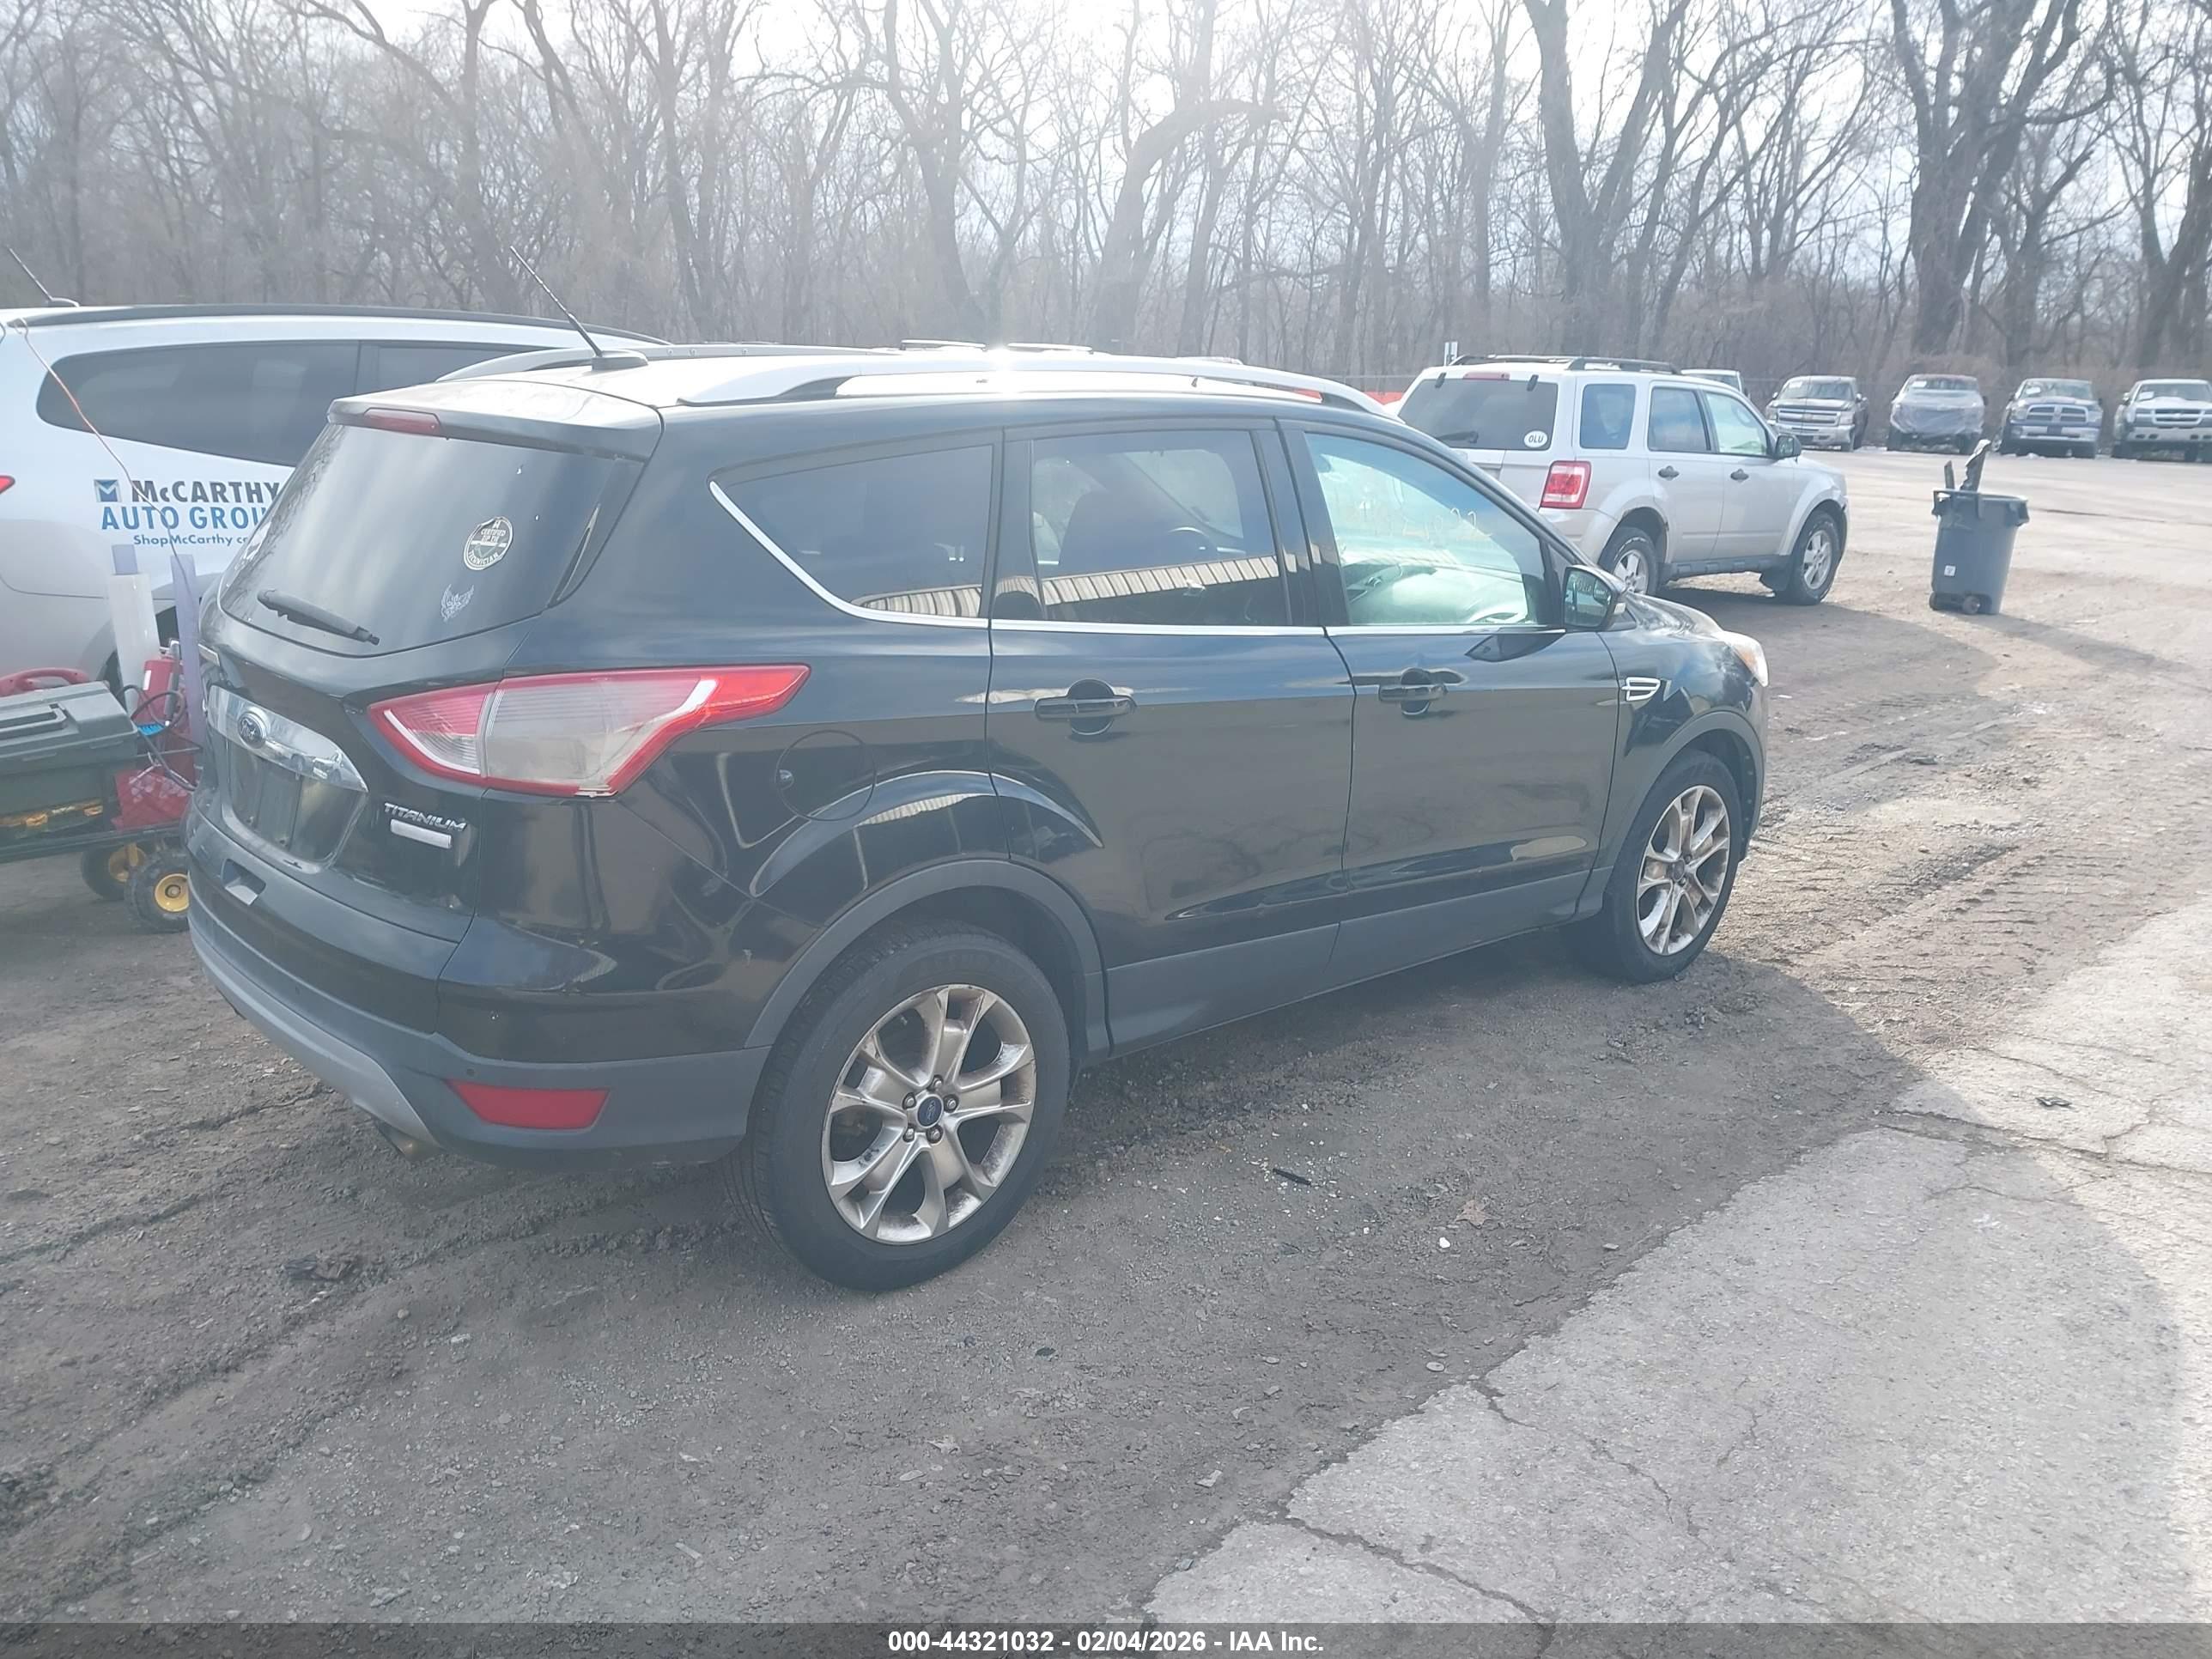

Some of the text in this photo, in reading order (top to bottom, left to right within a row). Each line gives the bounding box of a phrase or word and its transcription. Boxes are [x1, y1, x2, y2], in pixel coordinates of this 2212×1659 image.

[131, 480, 280, 503] McCARTHY
[101, 507, 179, 530] AUTO
[384, 802, 466, 832] TITANIUM
